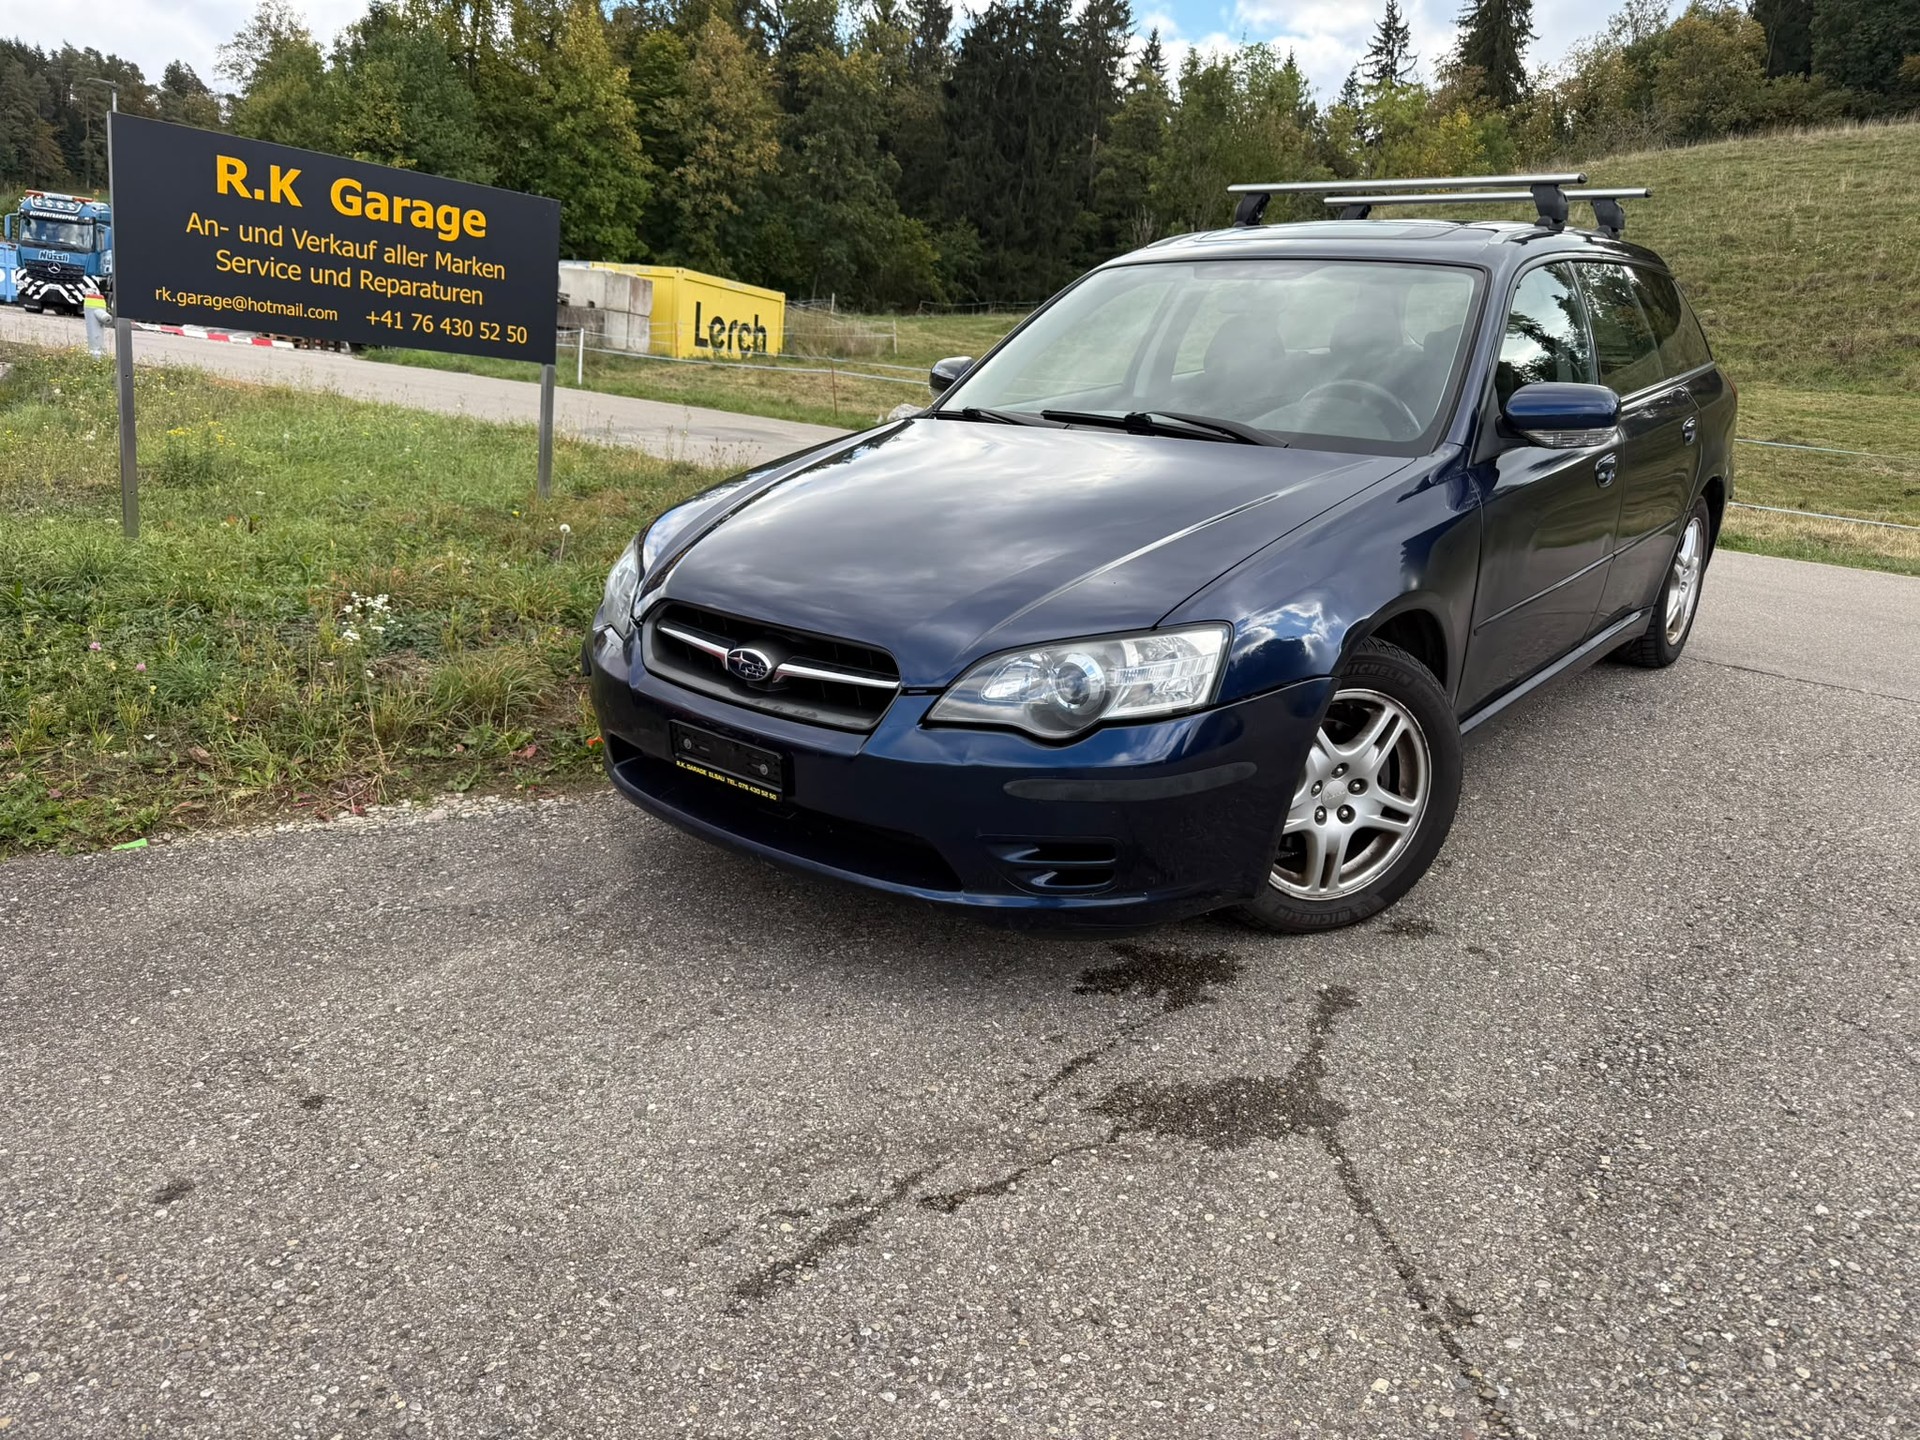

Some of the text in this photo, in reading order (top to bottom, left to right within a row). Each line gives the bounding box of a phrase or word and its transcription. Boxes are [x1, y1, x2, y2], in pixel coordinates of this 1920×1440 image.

[216, 154, 487, 242] R.K Garage
[39, 250, 69, 263] Nüssli
[186, 212, 506, 281] An- und Verkauf aller Marken
[216, 249, 484, 305] Service und Reparaturen
[155, 287, 528, 344] rk.garage@hotmail.com +41 76 430 52 50
[694, 301, 768, 352] Lerch
[686, 763, 707, 776] GARAGE
[738, 781, 749, 791] 076
[749, 786, 761, 795] 430
[761, 789, 769, 798] 52
[769, 792, 777, 800] 50
